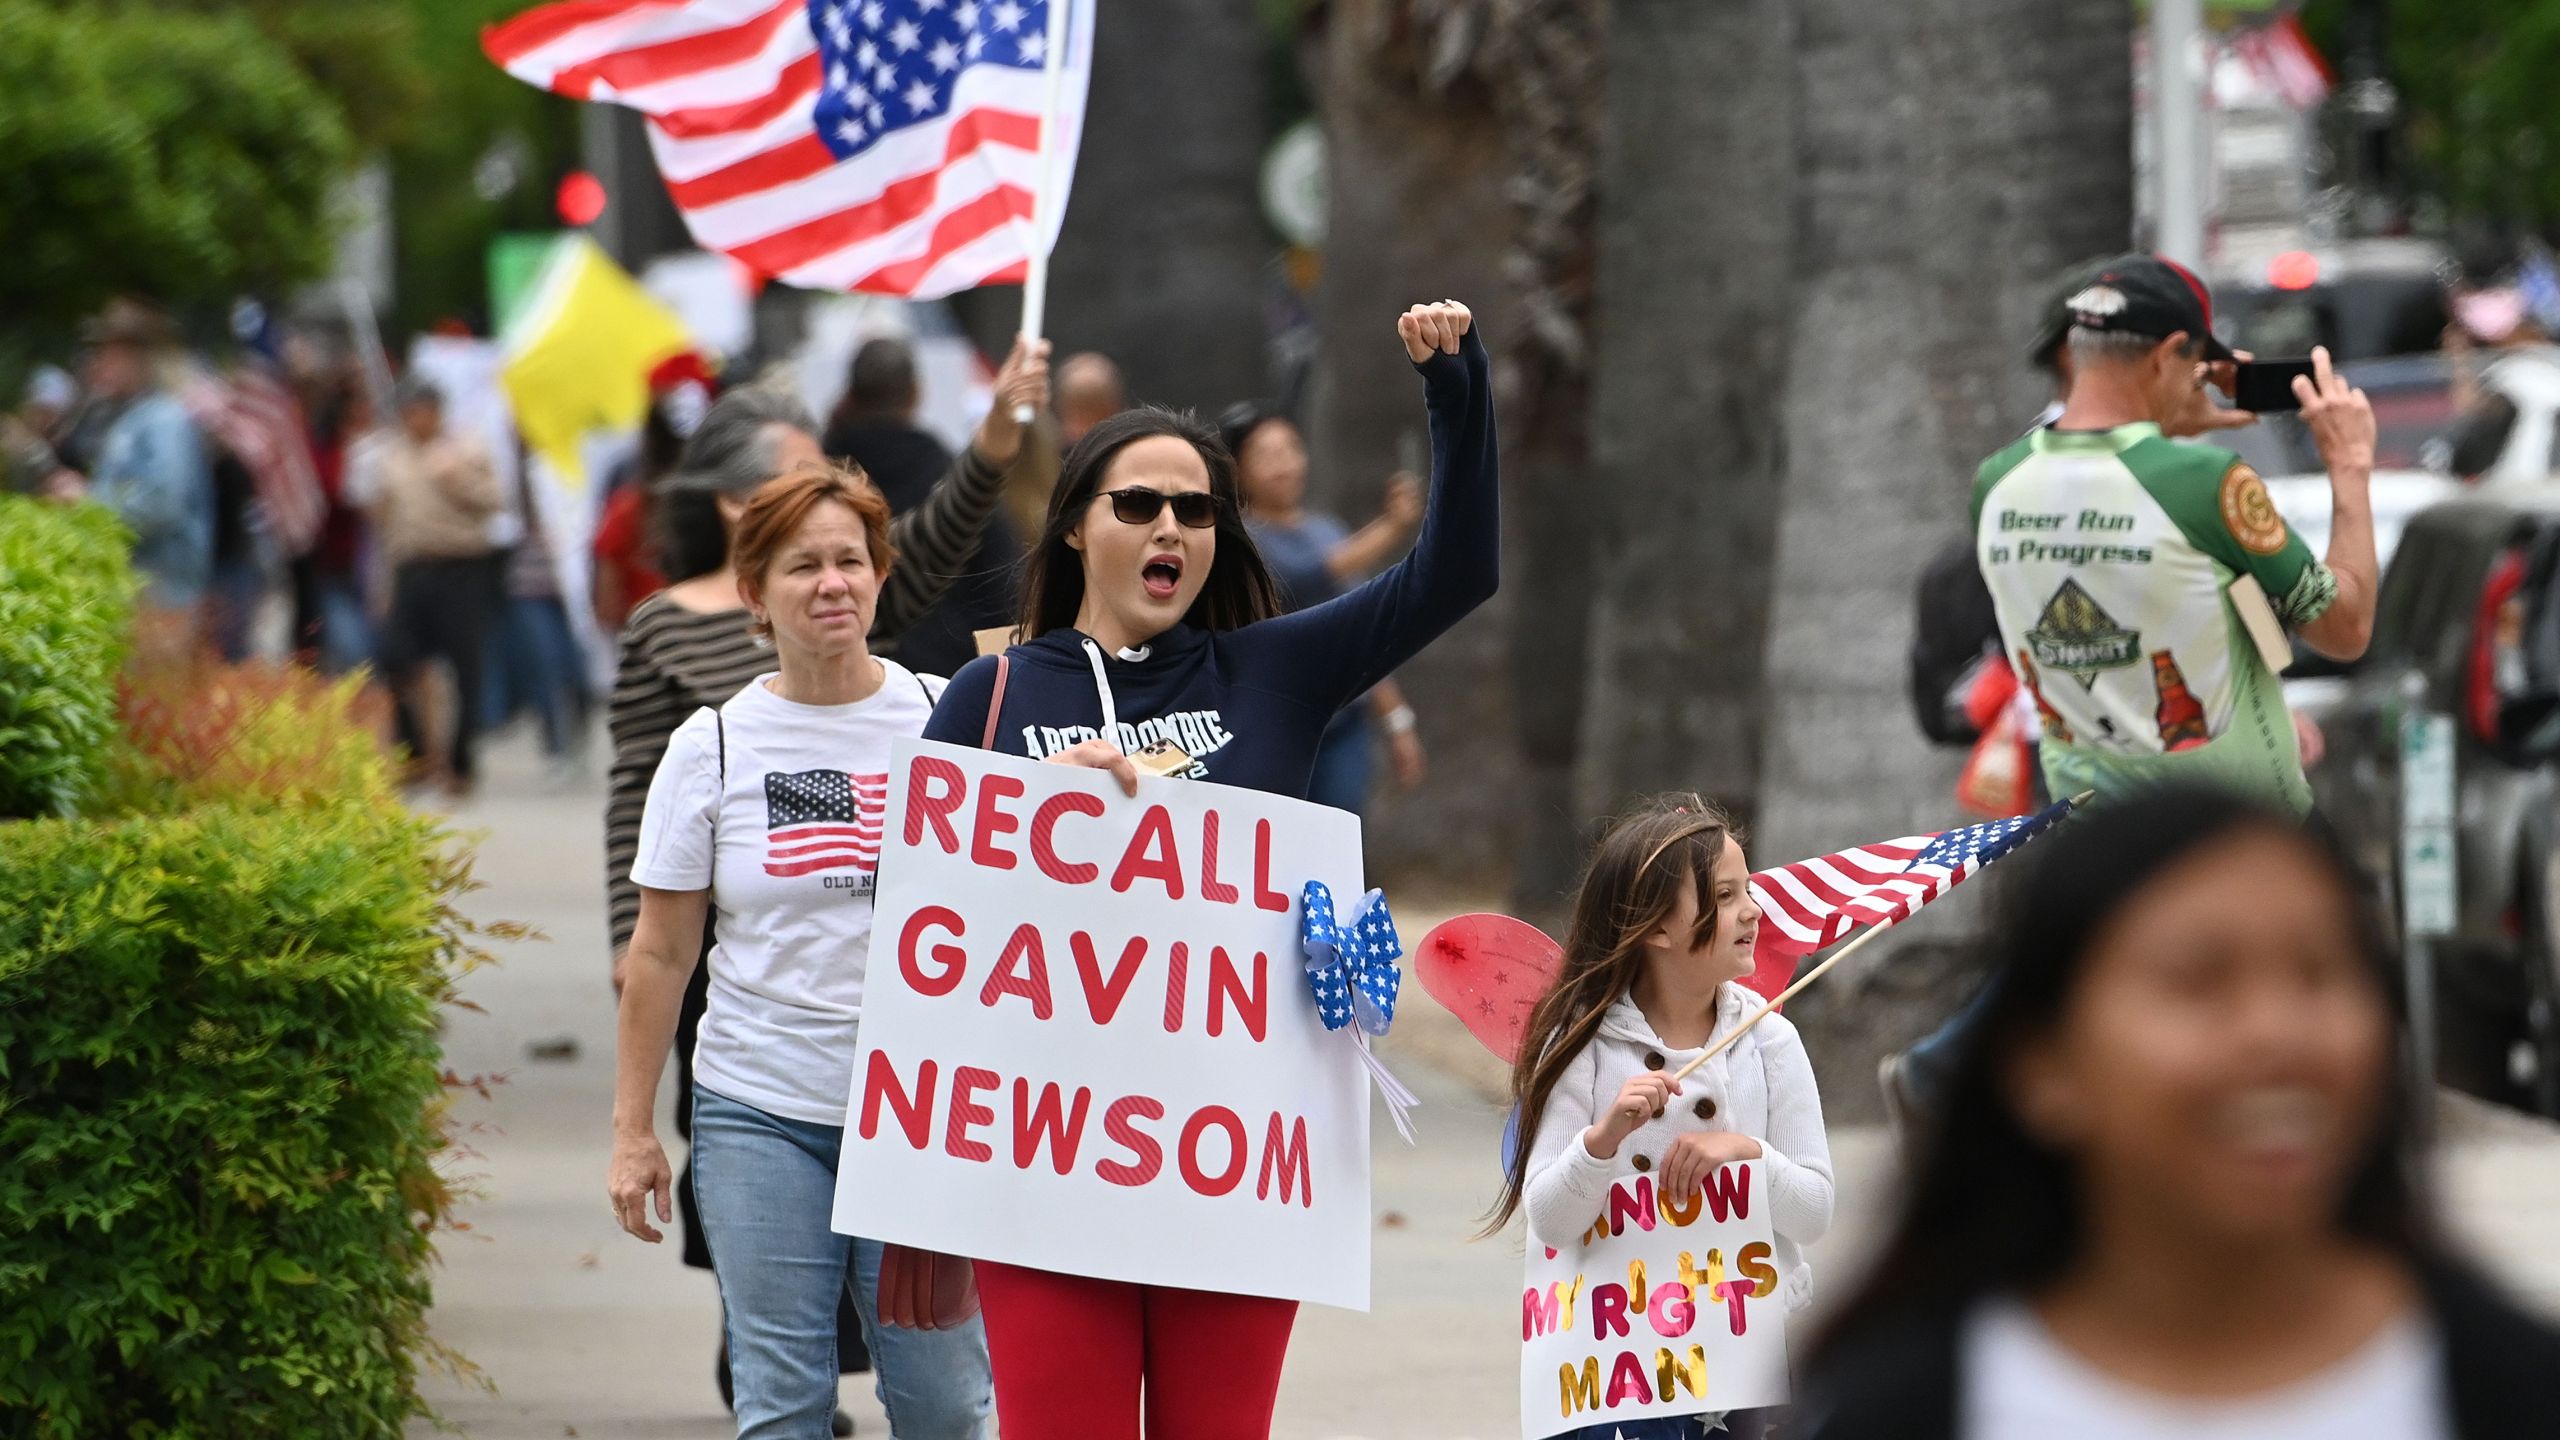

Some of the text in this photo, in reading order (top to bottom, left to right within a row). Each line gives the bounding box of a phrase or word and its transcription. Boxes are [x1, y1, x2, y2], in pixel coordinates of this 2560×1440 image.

[2000, 509, 2134, 531] Beer Run
[2019, 539, 2152, 567] Progress
[903, 755, 1290, 913] RECALL
[823, 876, 854, 889] OLD
[898, 905, 1268, 1042] GAVIN
[858, 1049, 1312, 1209] NEWSOM
[1522, 1272, 1584, 1342] MY
[1559, 1343, 1708, 1419] MAN
